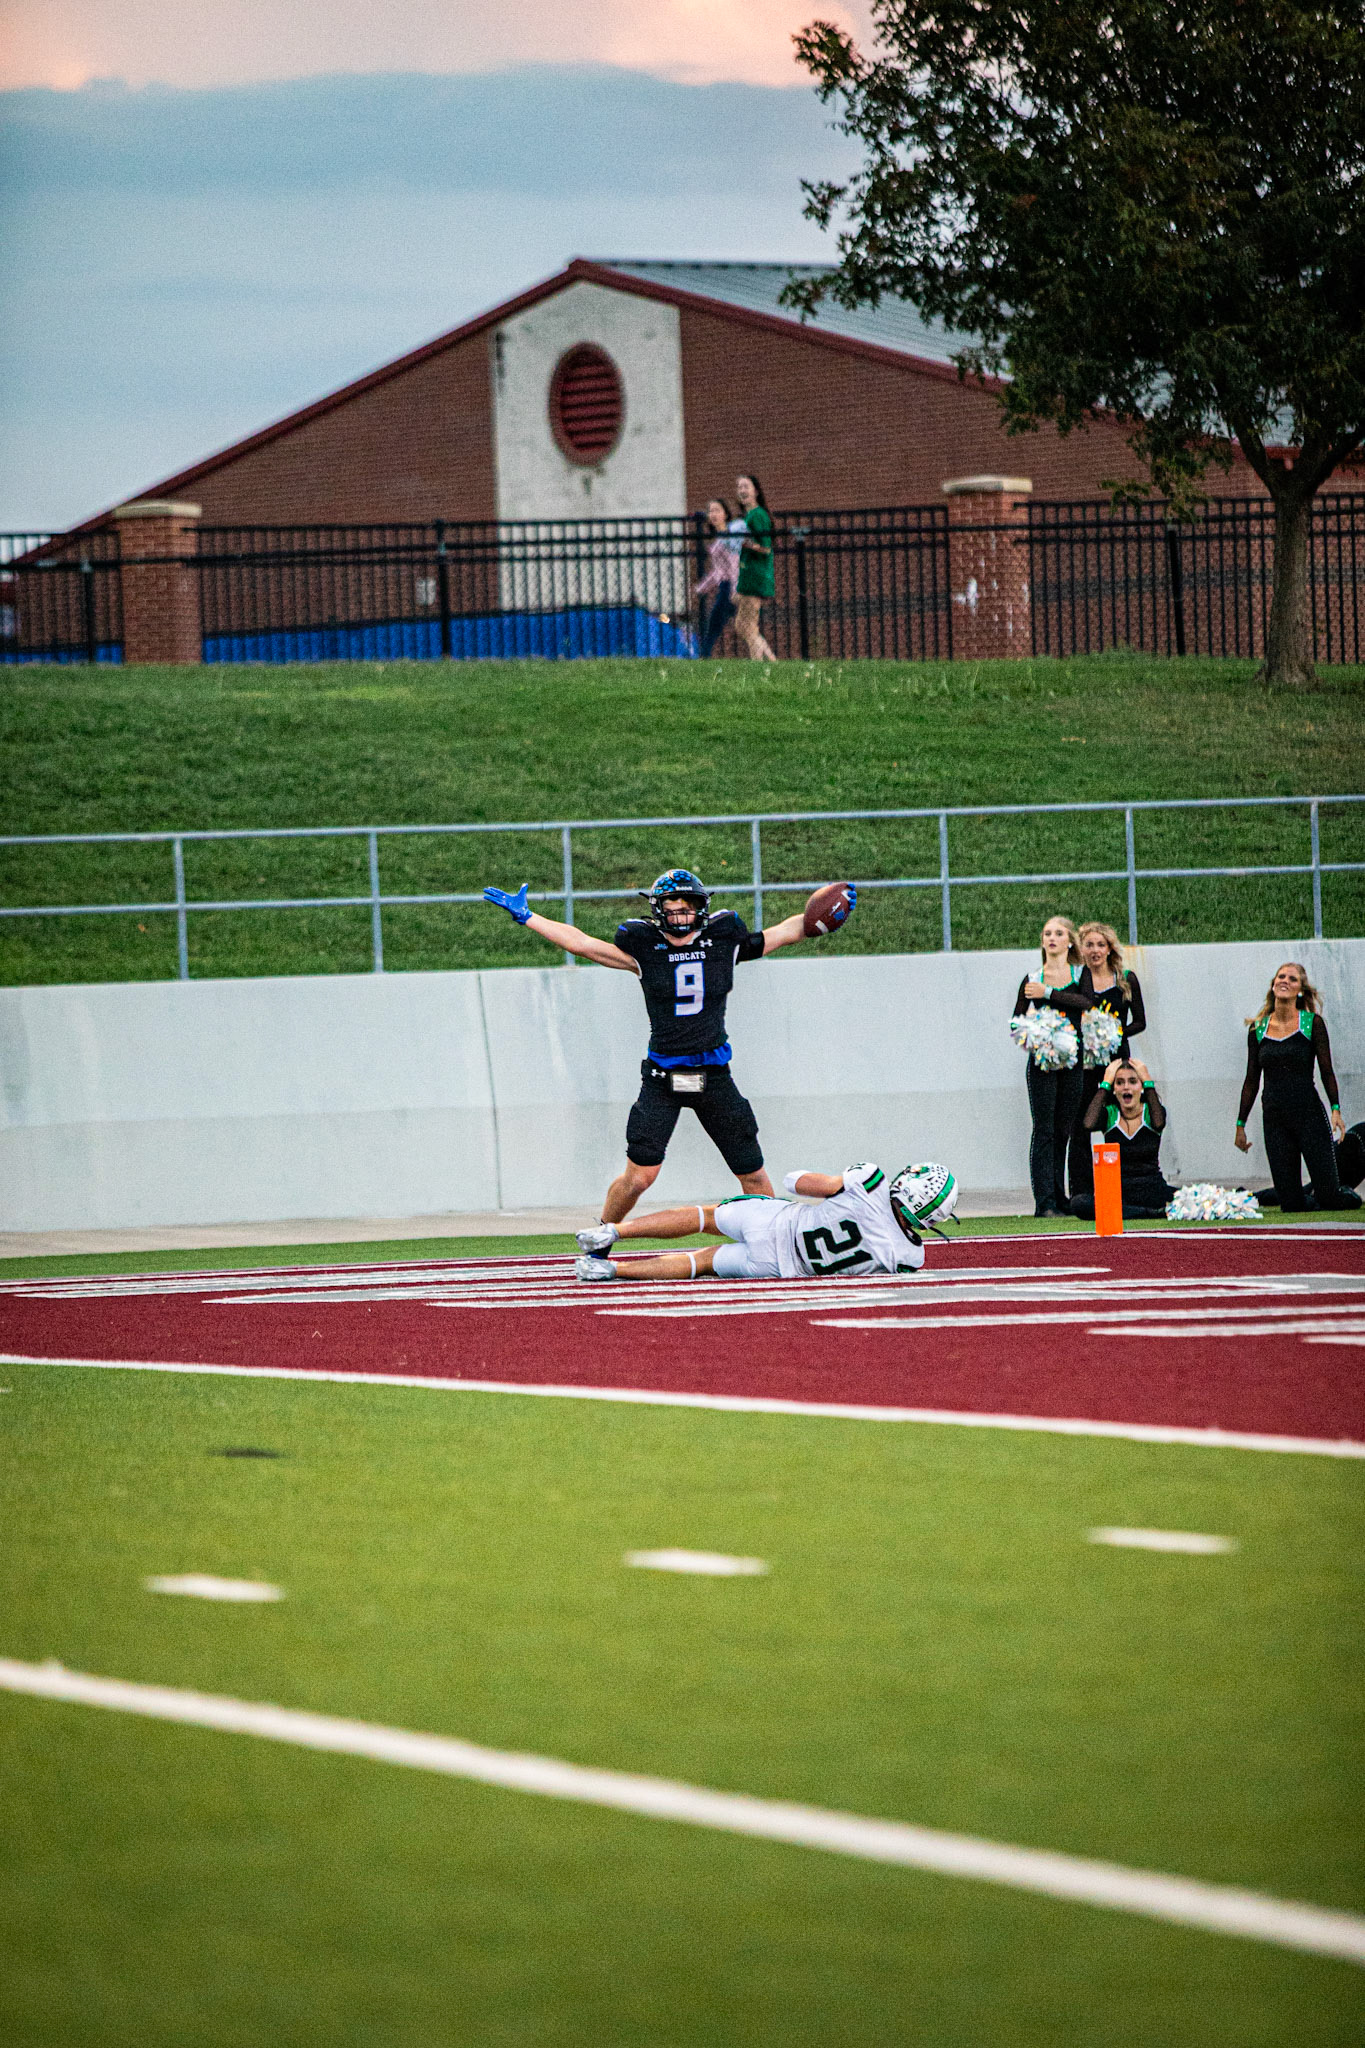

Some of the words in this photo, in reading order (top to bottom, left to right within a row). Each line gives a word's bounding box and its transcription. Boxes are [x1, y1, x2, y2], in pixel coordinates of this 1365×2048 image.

[668, 951, 706, 962] BOBCATS
[674, 961, 705, 1016] 9
[802, 1219, 874, 1275] 21
